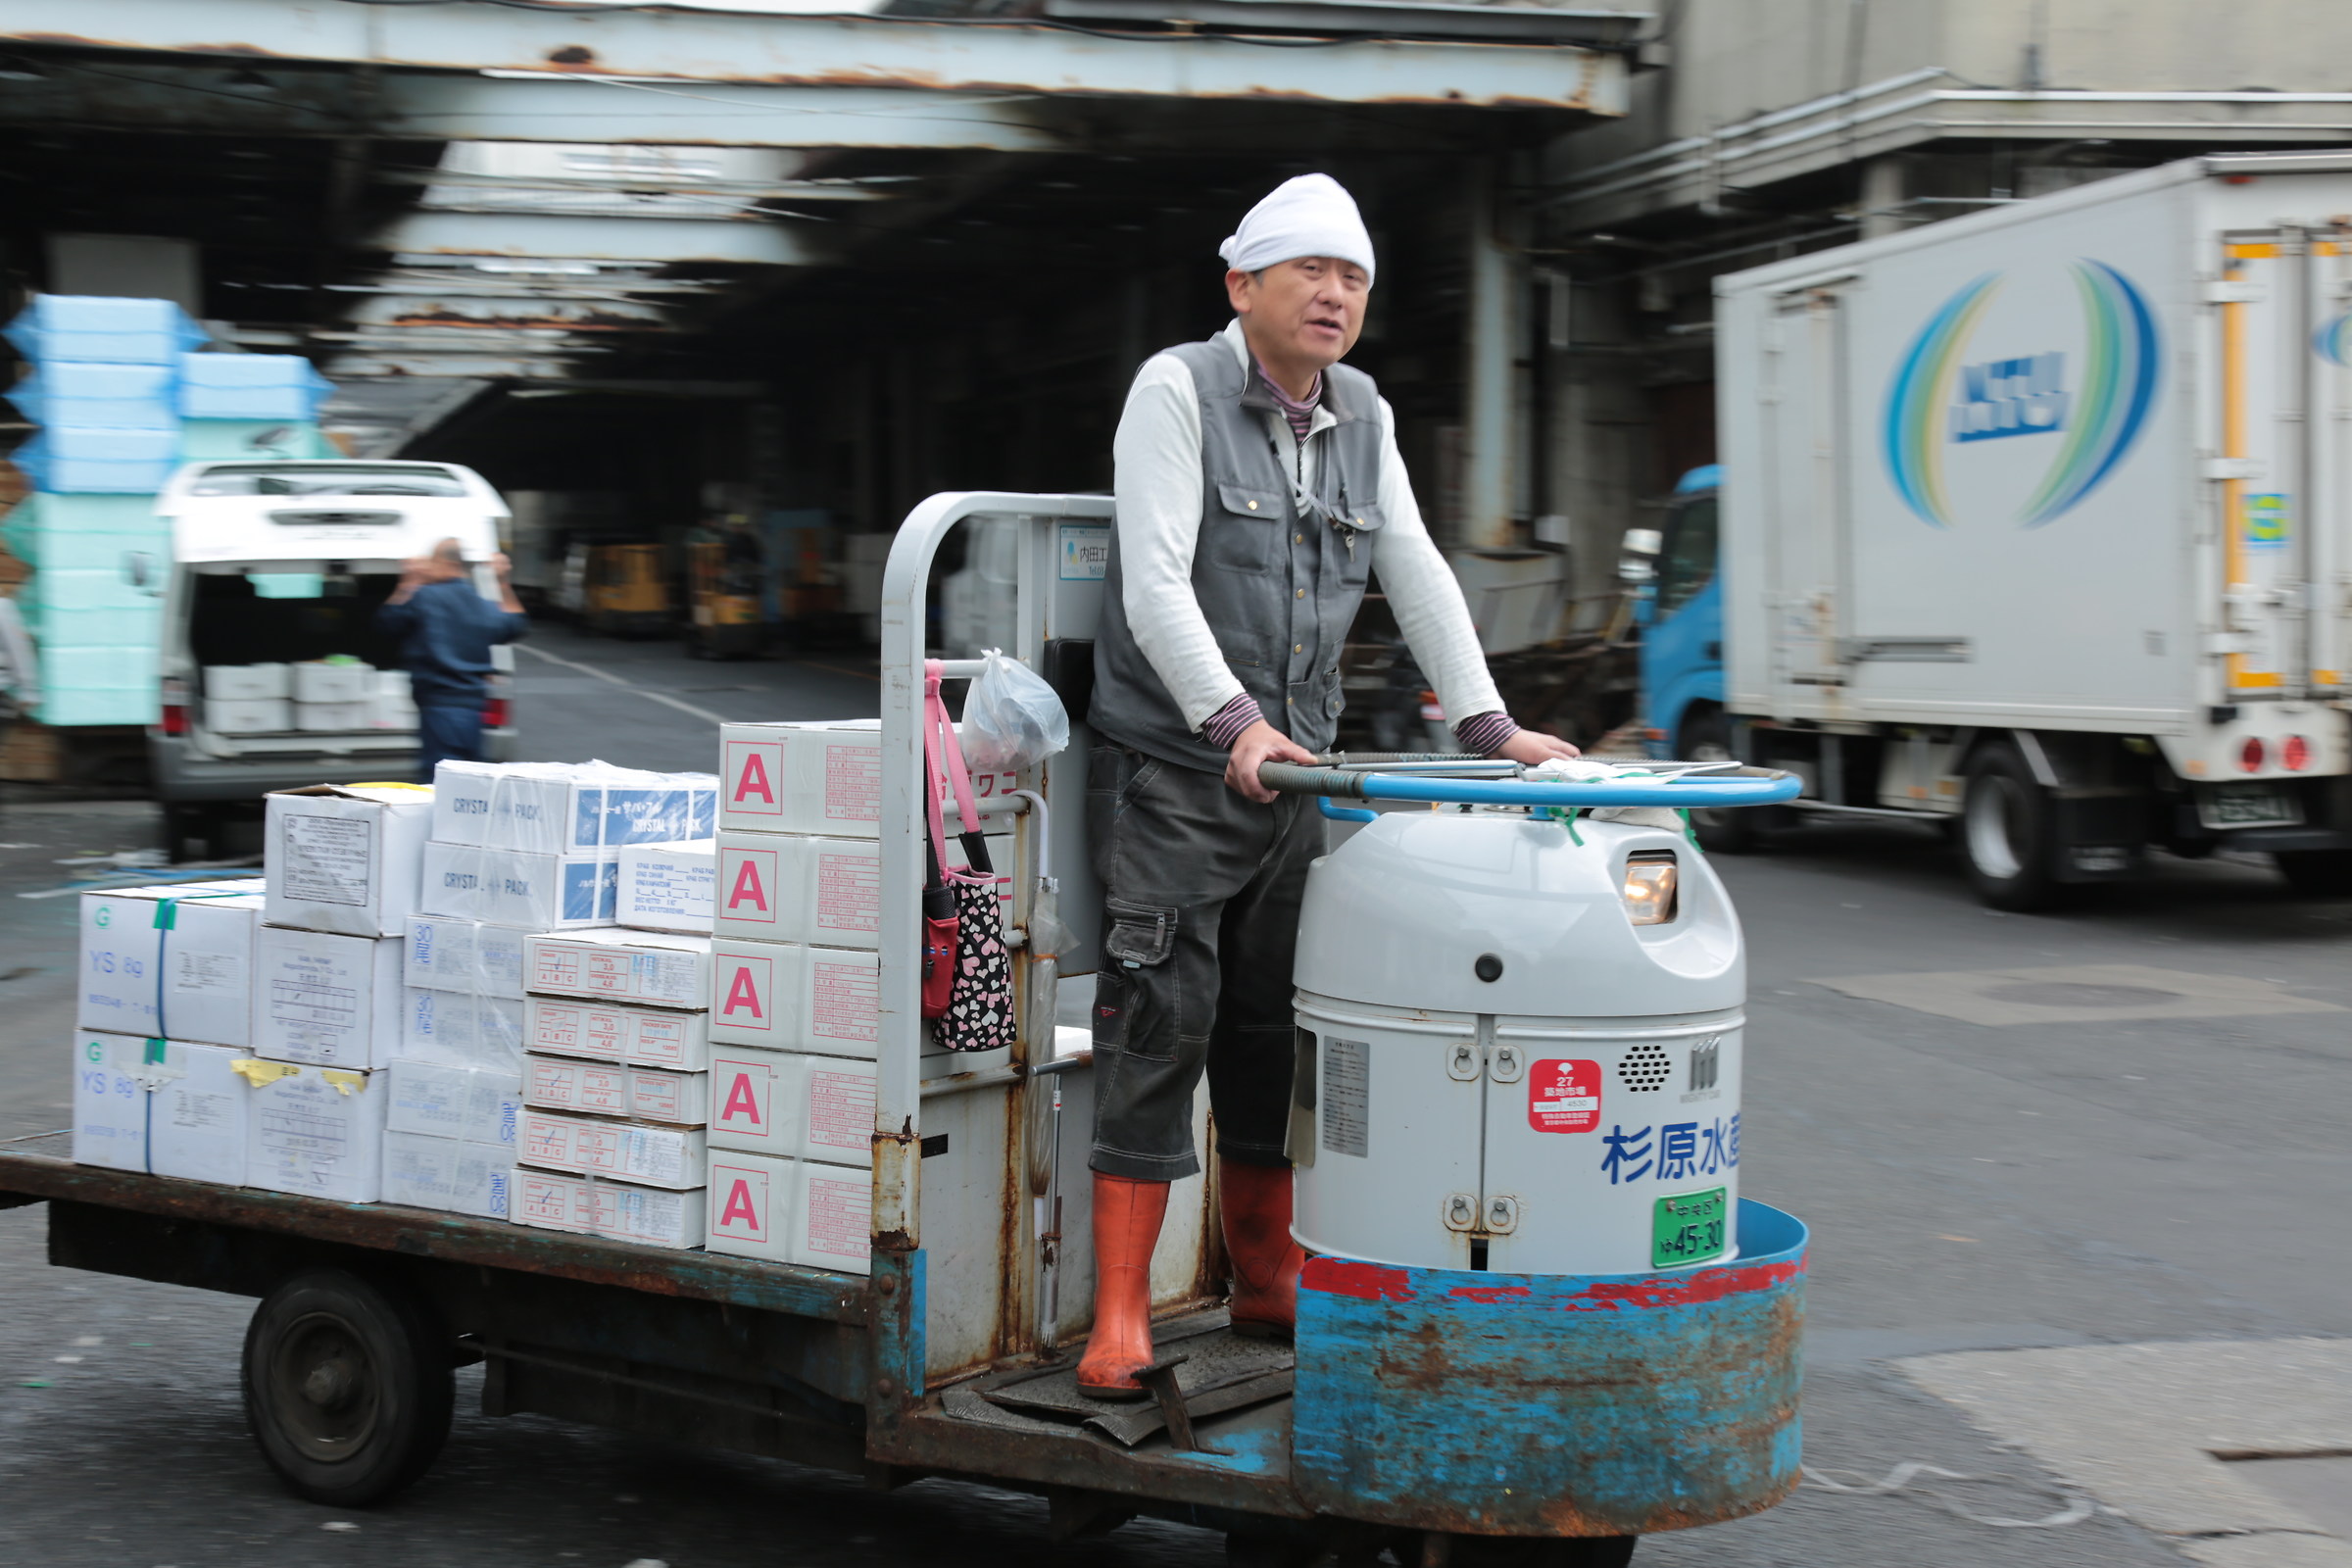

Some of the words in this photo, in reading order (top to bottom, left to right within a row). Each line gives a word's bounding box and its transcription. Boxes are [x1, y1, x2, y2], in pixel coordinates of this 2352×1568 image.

[734, 753, 774, 804] A
[453, 797, 494, 816] CRYSTA
[443, 871, 485, 892] CRYSTA
[727, 859, 768, 911] A
[95, 906, 112, 928] G
[722, 966, 763, 1019] A
[86, 1041, 104, 1062] G
[1556, 1076, 1574, 1087] 27
[720, 1072, 761, 1125] A
[720, 1179, 760, 1231] A
[1677, 1199, 1714, 1218] 中央区
[1674, 1219, 1722, 1256] 45-30
